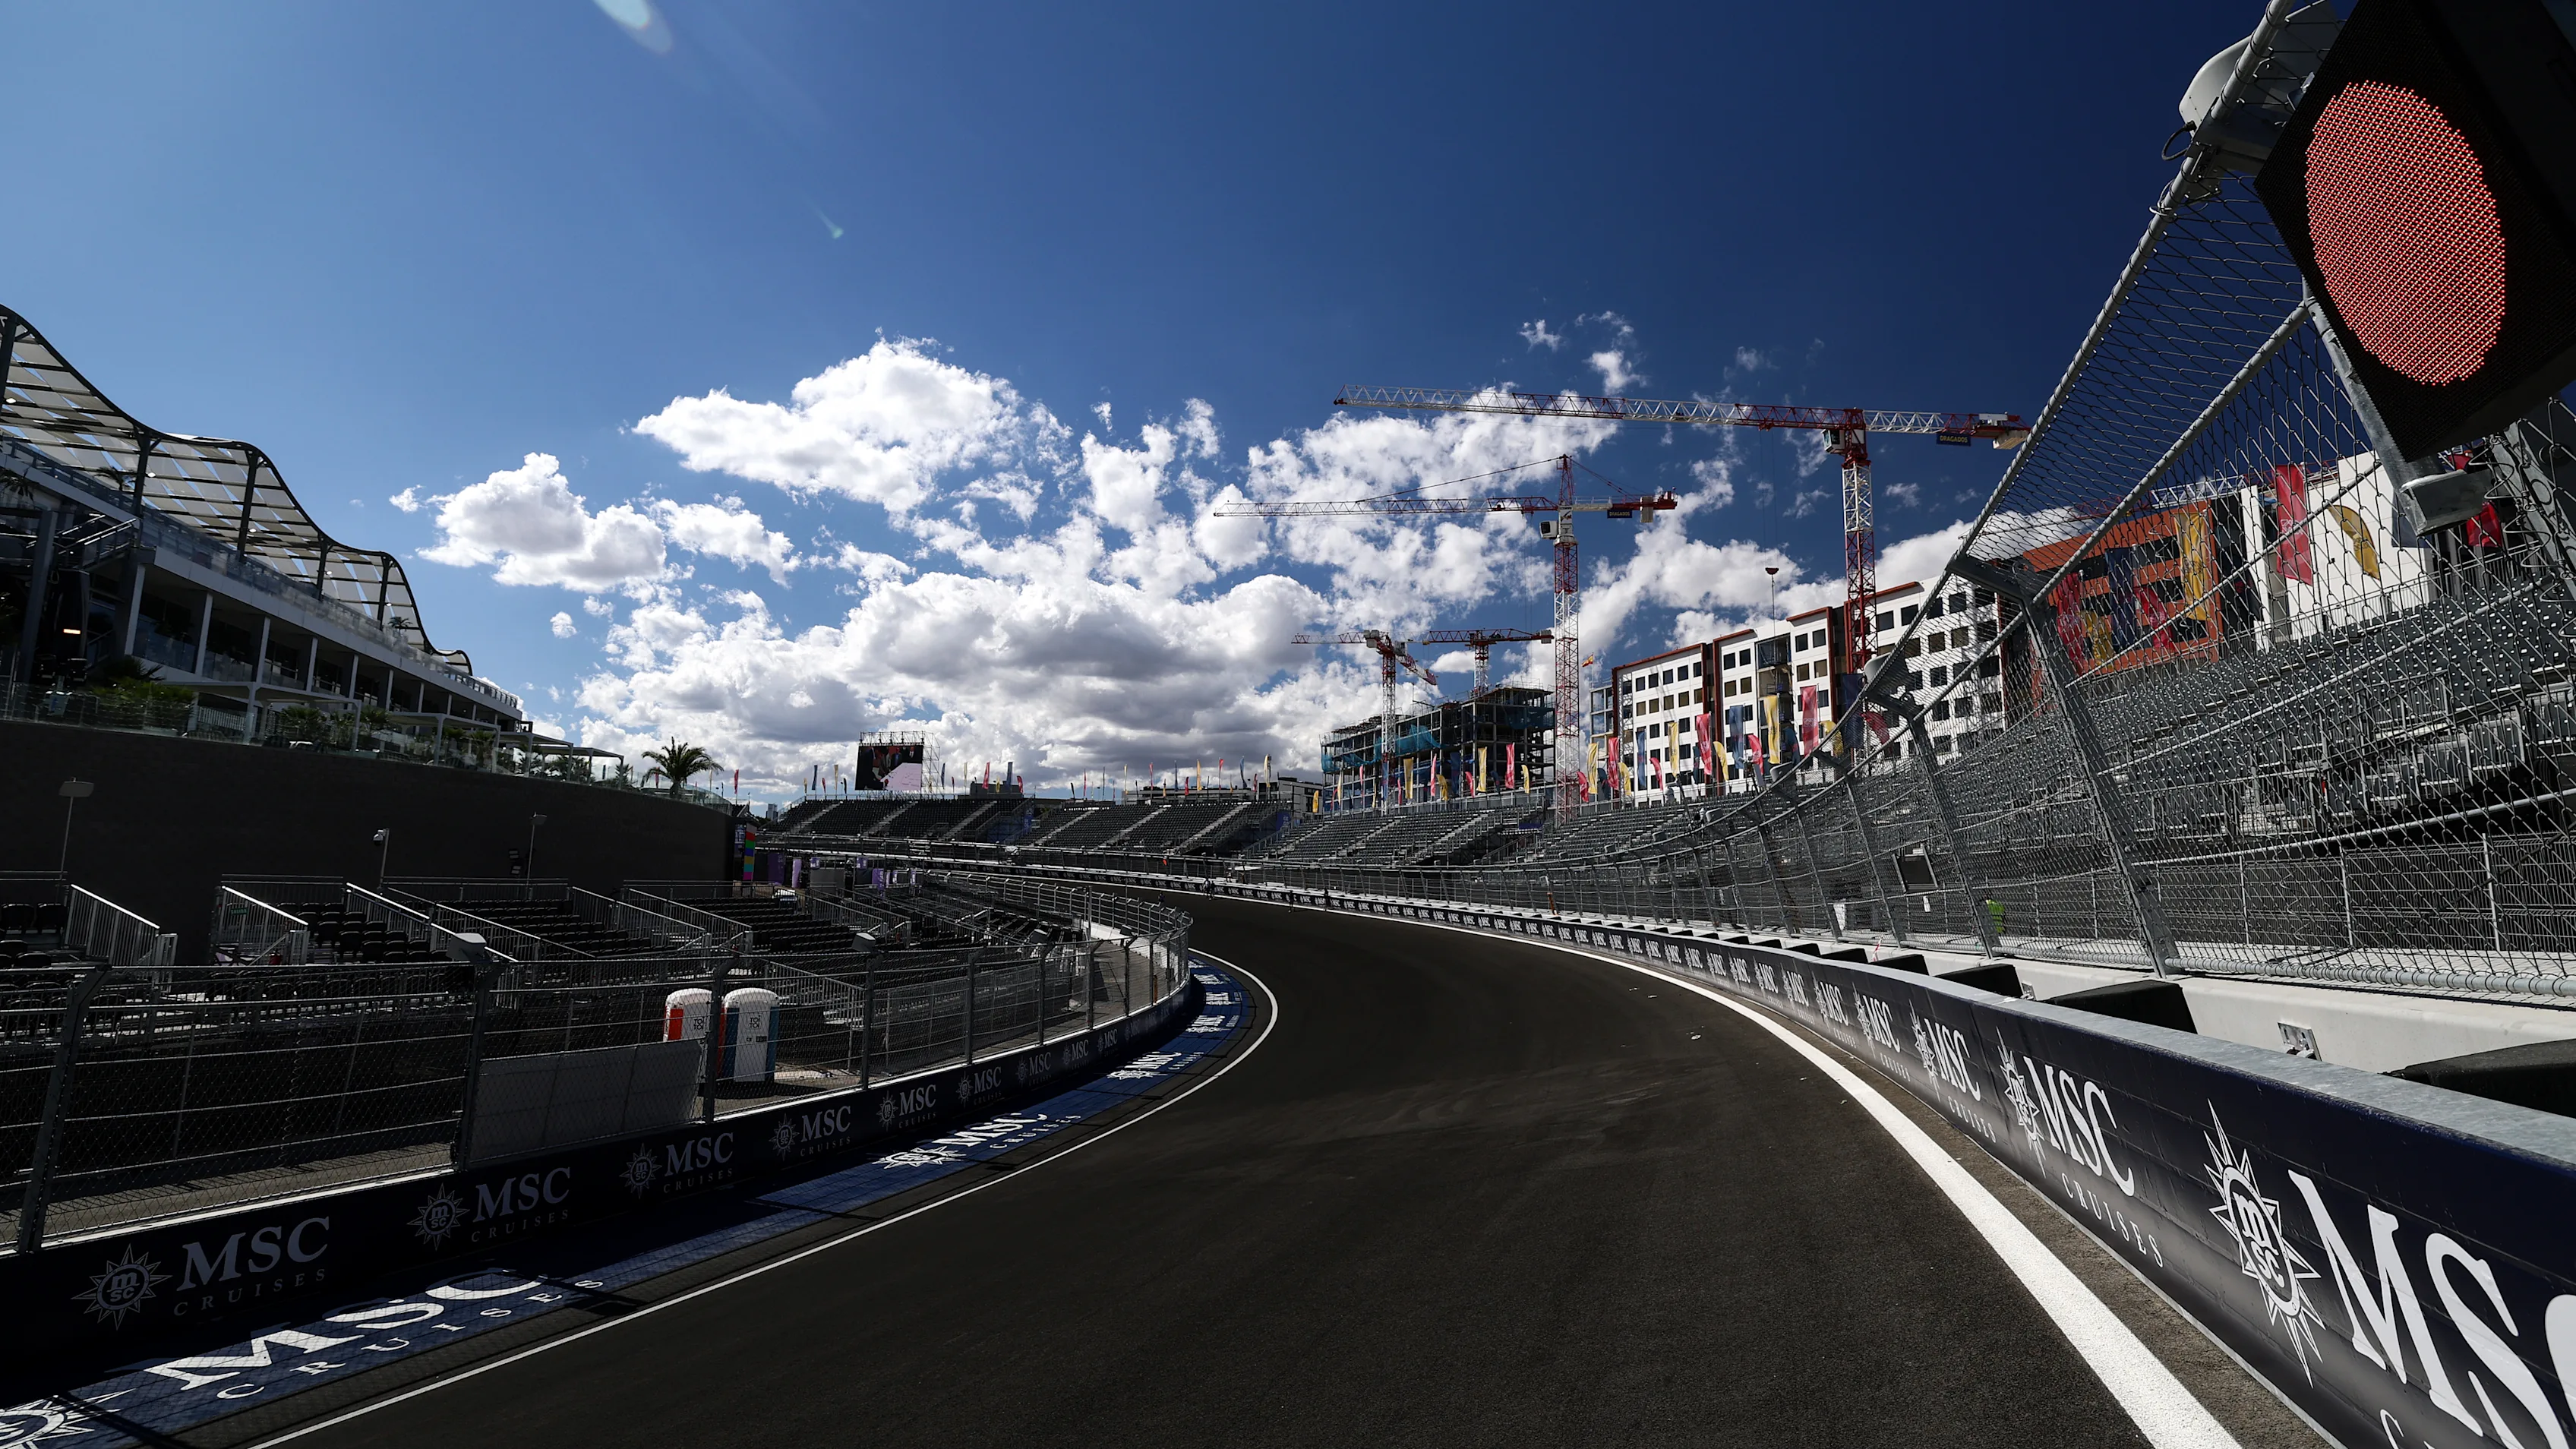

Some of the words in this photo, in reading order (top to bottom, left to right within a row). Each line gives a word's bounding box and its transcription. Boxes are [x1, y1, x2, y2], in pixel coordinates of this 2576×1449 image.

[1709, 952, 1726, 977] MSC
[1732, 957, 1751, 983] MSC
[1758, 962, 1779, 993] MSC
[1786, 971, 1810, 1007] MSC
[1820, 982, 1849, 1026] MSC
[1103, 1028, 1119, 1050] MSC
[1862, 995, 1901, 1053] MSC
[1028, 1051, 1052, 1077] MSC
[1071, 1038, 1090, 1062] MSC
[1924, 1018, 1981, 1101] MSC
[973, 1066, 1003, 1096] MSC
[898, 1084, 937, 1117] MSC
[800, 1105, 852, 1143] MSC
[898, 1111, 937, 1129] CRUISES
[921, 1111, 1049, 1148] MSC
[1948, 1096, 1997, 1144] CRUISES
[2023, 1056, 2135, 1197] MSC
[664, 1132, 734, 1177] MSC
[799, 1137, 851, 1157] CRUISES
[472, 1166, 572, 1223] MSC
[663, 1167, 734, 1195] CRUISES
[430, 1205, 450, 1219] m
[431, 1216, 447, 1229] sc
[471, 1209, 569, 1242] CRUISES
[2061, 1173, 2164, 1268] CRUISES
[2232, 1192, 2279, 1255] m
[175, 1215, 330, 1292] MSC
[2251, 1240, 2285, 1287] sc
[109, 1271, 140, 1293] m
[110, 1289, 134, 1302] sc
[173, 1267, 326, 1317] CRUISES
[2287, 1170, 2576, 1449] MS
[104, 1267, 548, 1391] MSC
[216, 1279, 605, 1399] CRUISES
